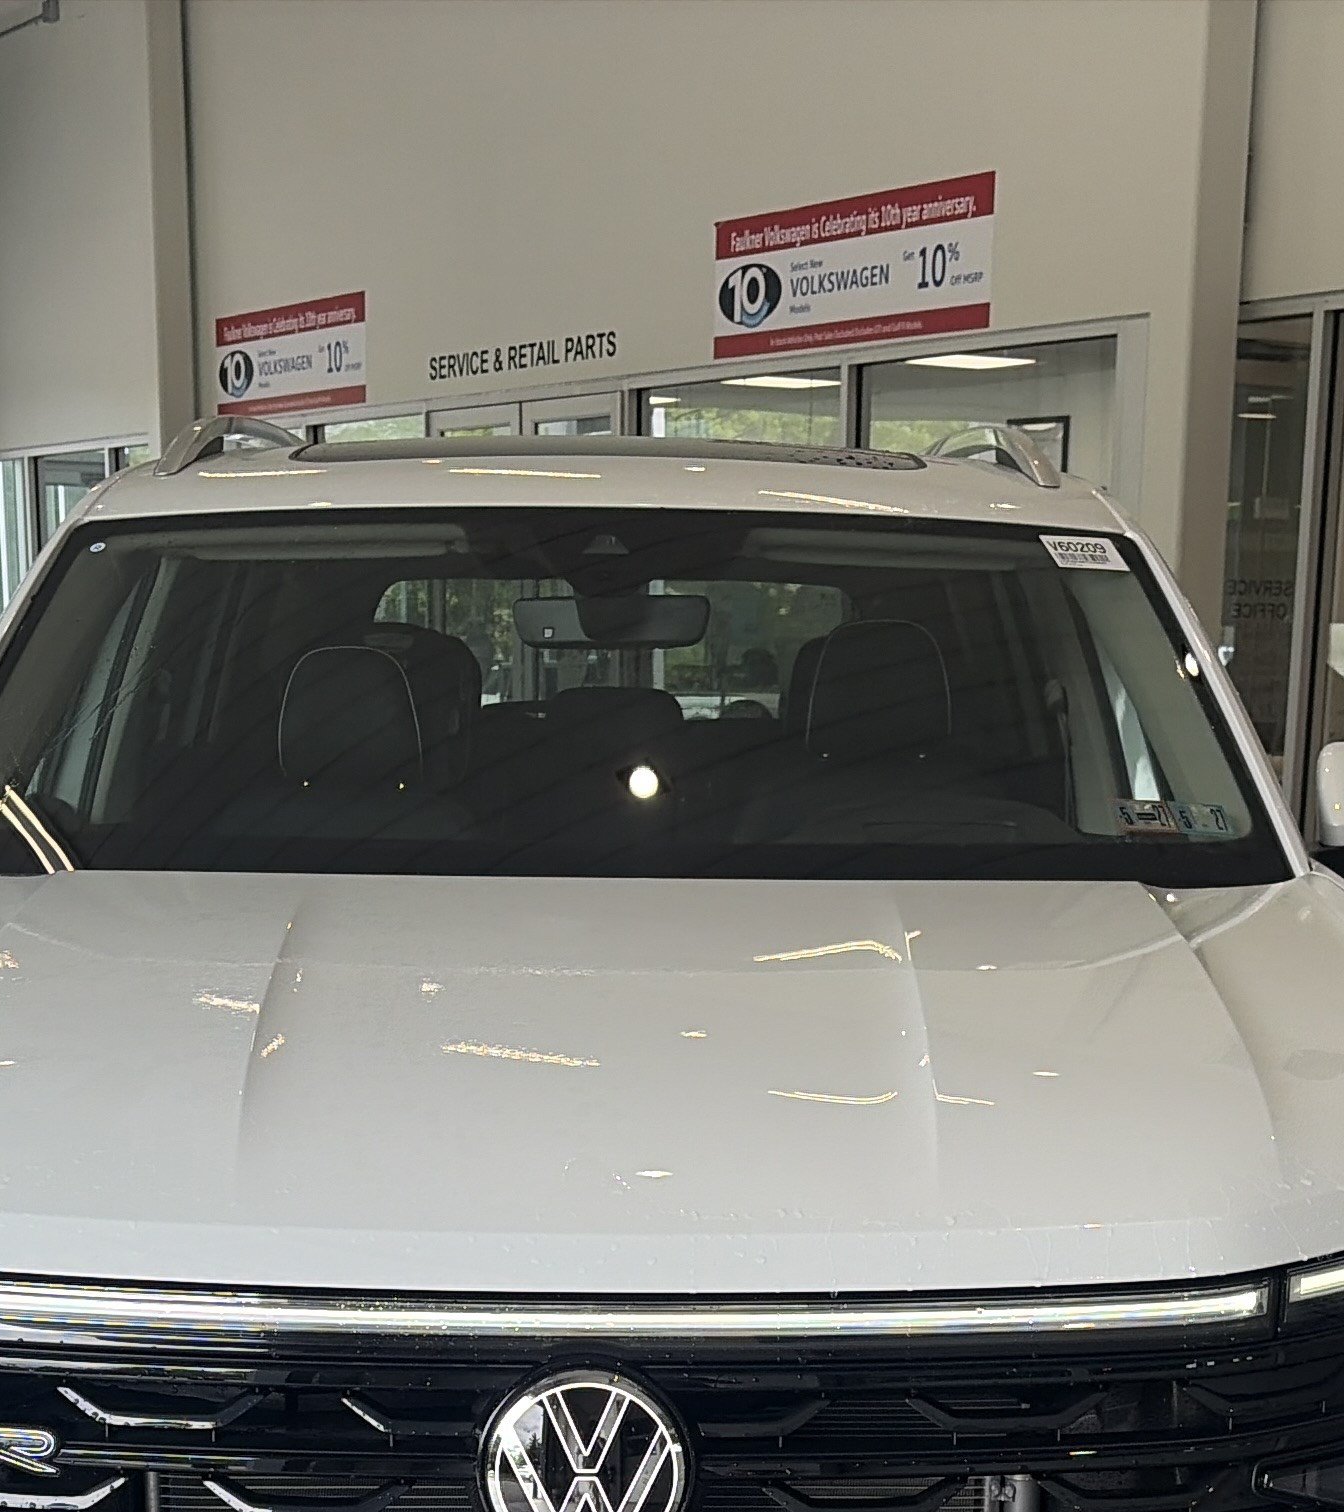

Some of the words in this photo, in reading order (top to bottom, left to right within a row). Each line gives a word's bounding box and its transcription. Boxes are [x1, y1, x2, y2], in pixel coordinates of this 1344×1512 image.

[764, 224, 810, 247] Volkswagen
[812, 217, 819, 239] is
[820, 210, 866, 237] Celebrating
[881, 203, 901, 227] 10th
[901, 204, 922, 229] year
[727, 266, 767, 324] 10
[790, 263, 890, 298] VOLKSWAGEN
[223, 352, 246, 396] 10
[258, 354, 313, 377] VOLKSWAGEN
[429, 349, 489, 381] SERVICE
[493, 347, 504, 373] &
[507, 339, 560, 371] RETAIL
[564, 330, 617, 363] PARTS
[1046, 541, 1107, 554] V60209
